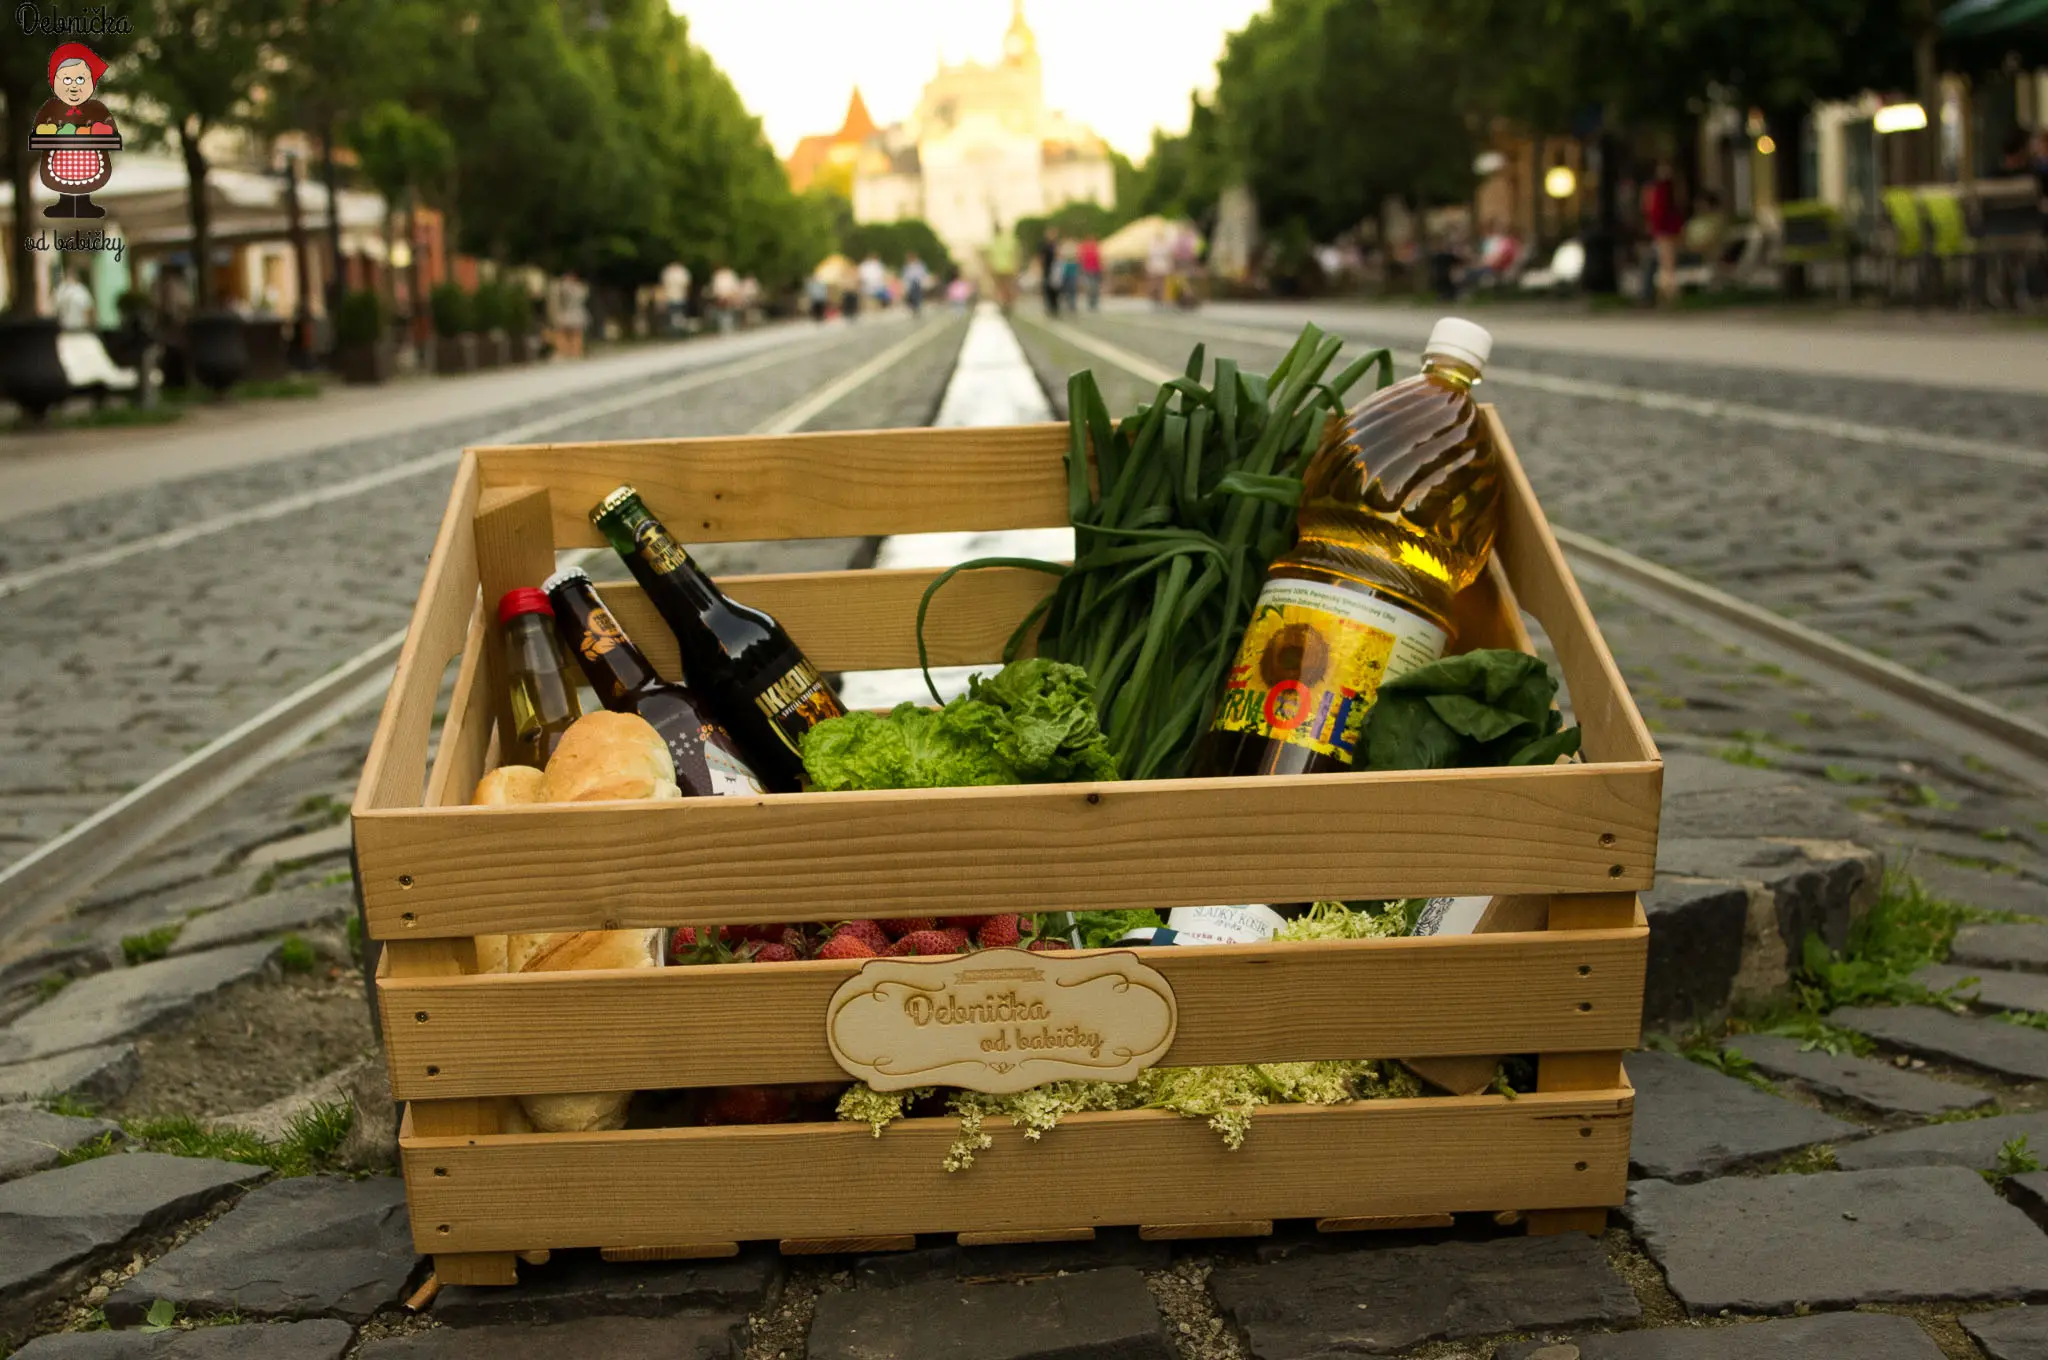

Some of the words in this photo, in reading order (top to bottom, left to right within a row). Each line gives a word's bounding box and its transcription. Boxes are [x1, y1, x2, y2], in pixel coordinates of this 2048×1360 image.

[904, 992, 1051, 1027] Debnička
[980, 1030, 1011, 1052] od
[1016, 1025, 1104, 1059] babičky
